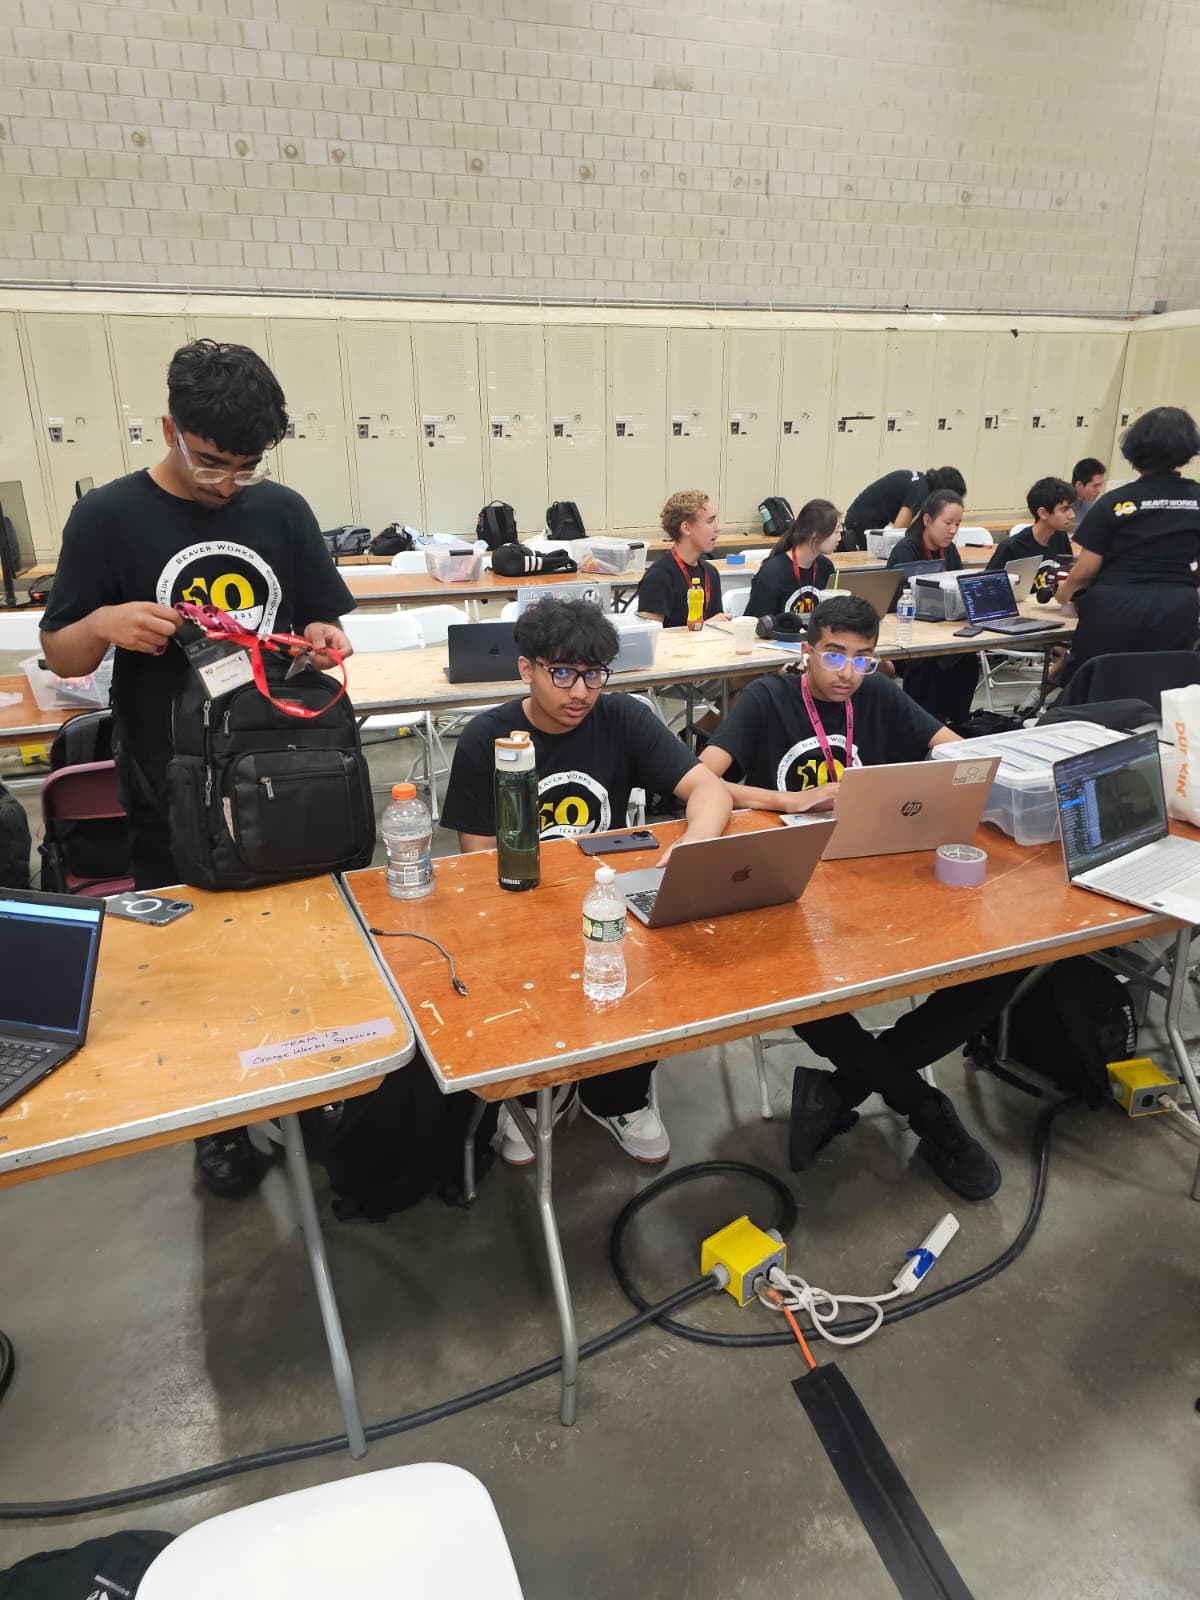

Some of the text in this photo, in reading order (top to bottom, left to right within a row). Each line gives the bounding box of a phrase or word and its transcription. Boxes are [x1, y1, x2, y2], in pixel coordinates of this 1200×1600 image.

[176, 545, 254, 564] BEAVER WORKS
[161, 578, 169, 595] MIT
[901, 800, 922, 816] hp
[281, 1036, 318, 1047] TEAM
[253, 1053, 290, 1065] Orange
